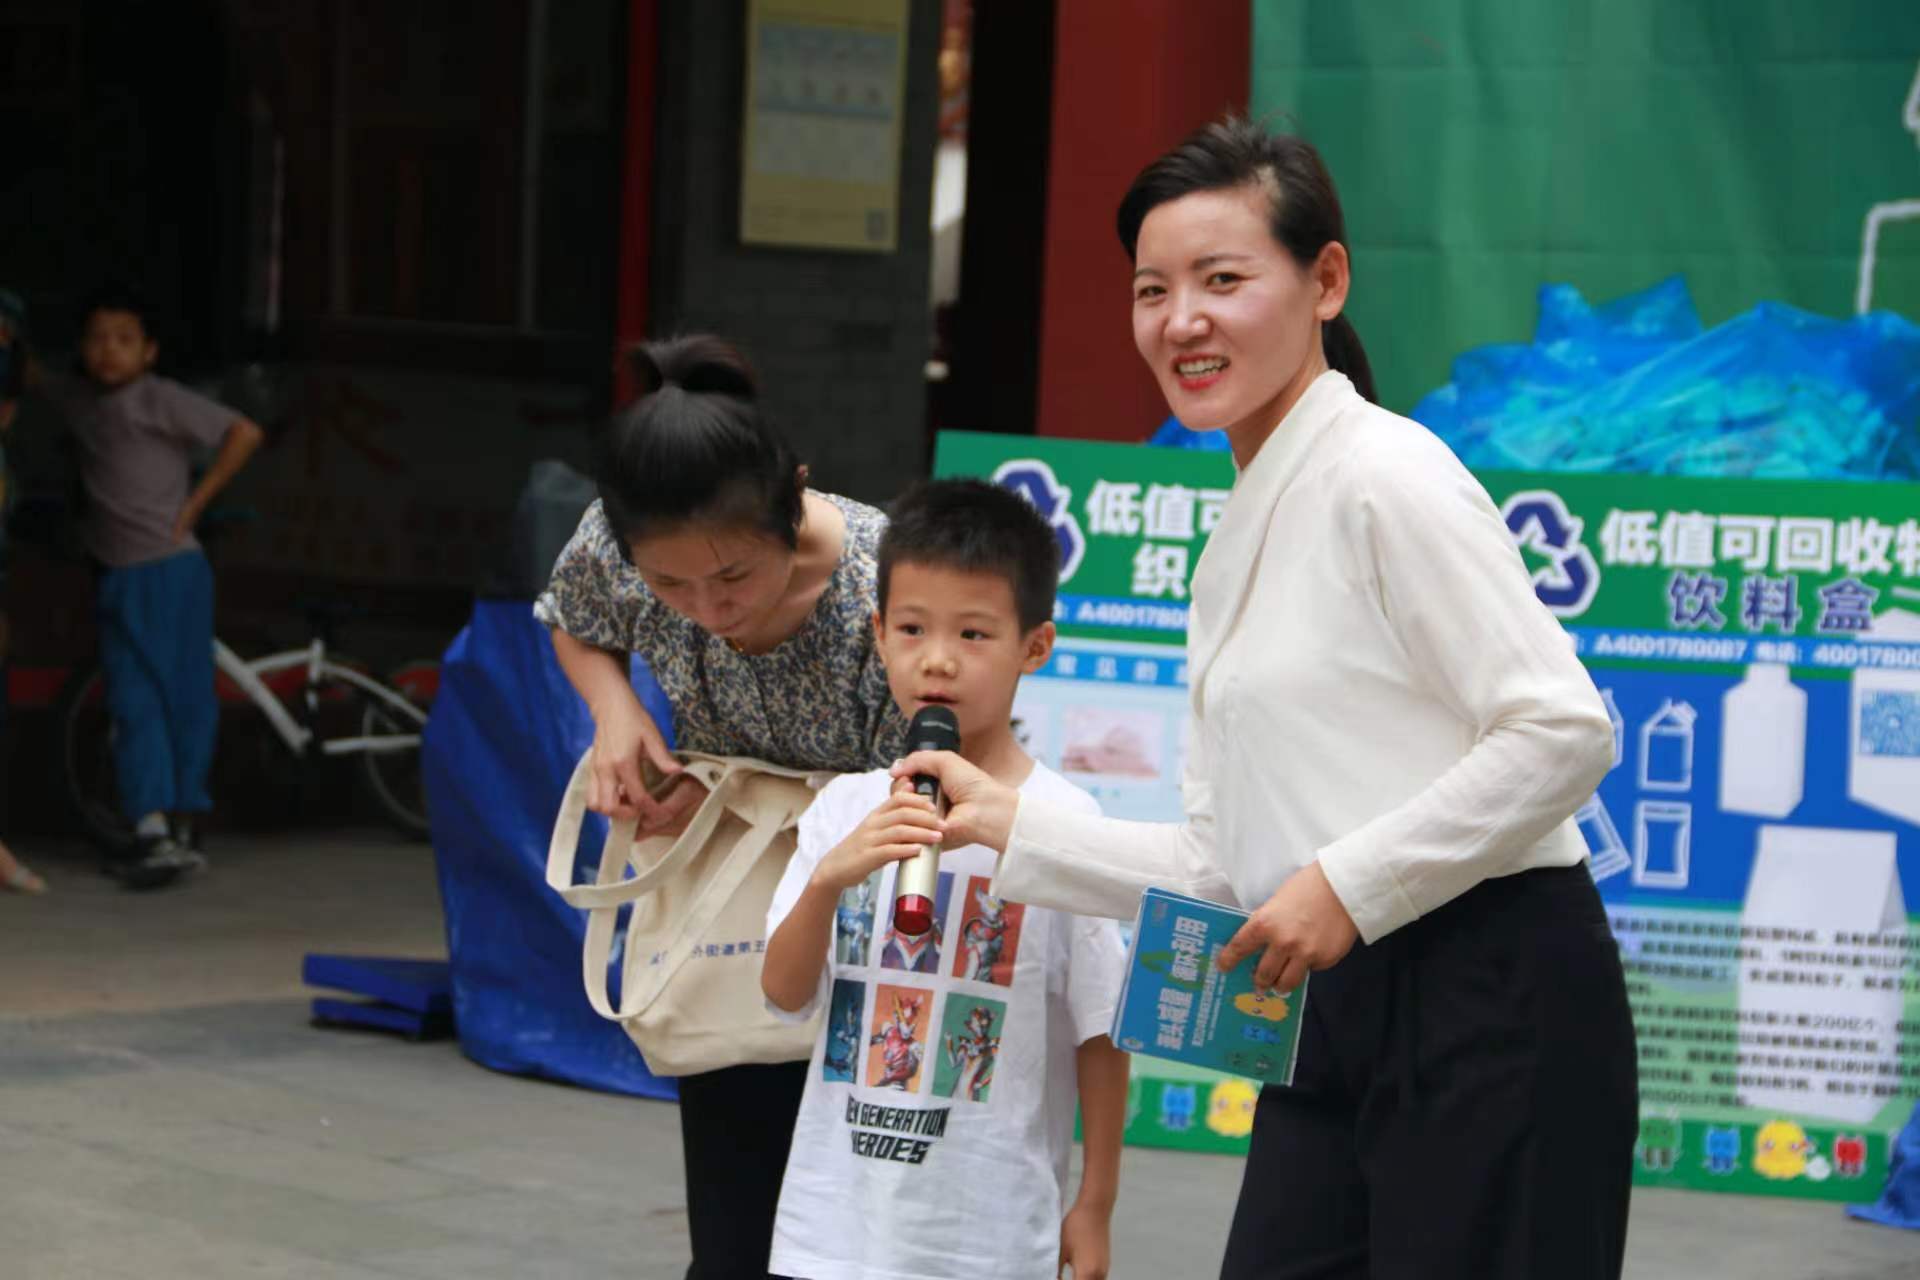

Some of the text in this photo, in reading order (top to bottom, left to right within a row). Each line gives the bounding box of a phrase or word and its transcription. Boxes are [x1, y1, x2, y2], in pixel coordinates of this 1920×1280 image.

[1668, 570, 1880, 633] 饮料盒
[860, 1103, 952, 1138] GENERATION
